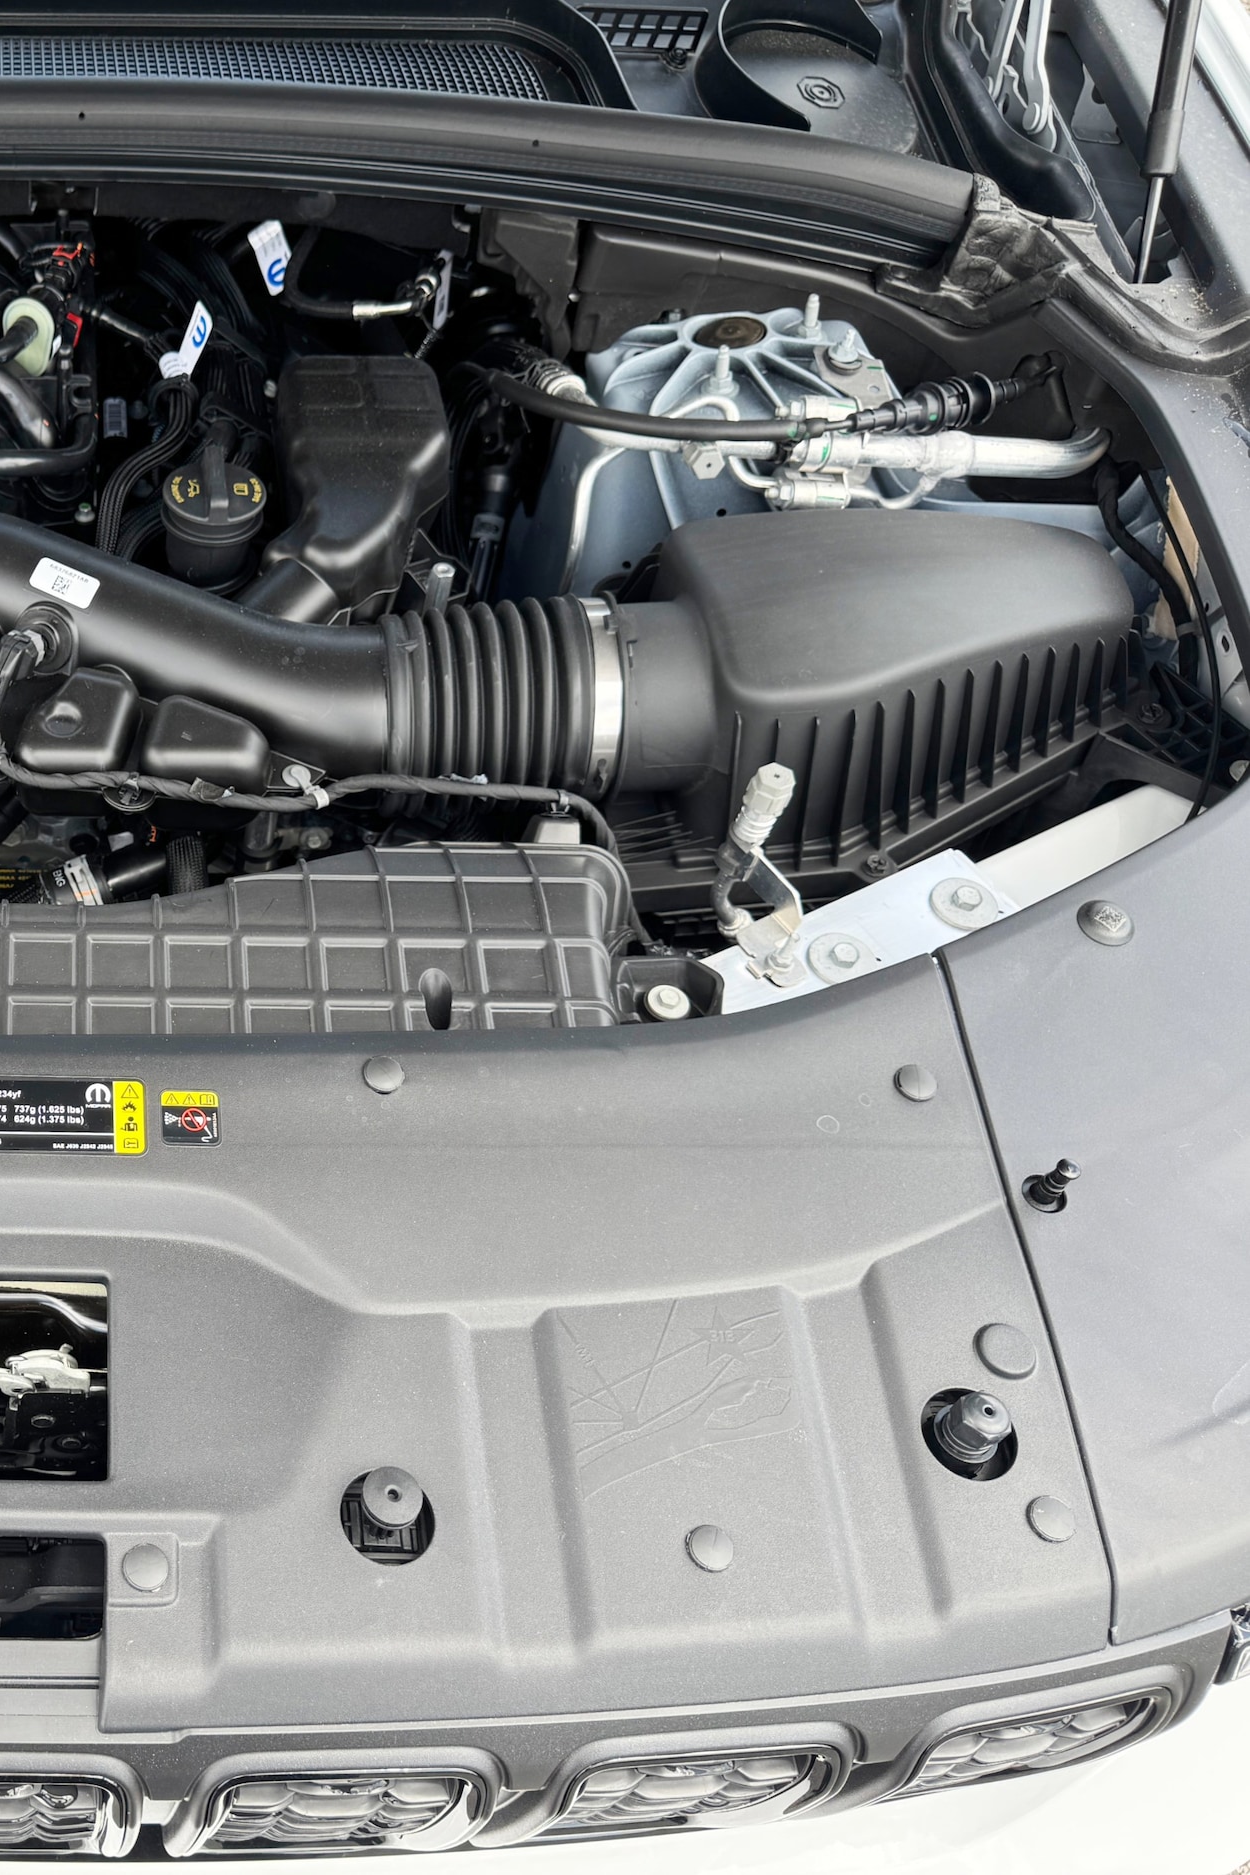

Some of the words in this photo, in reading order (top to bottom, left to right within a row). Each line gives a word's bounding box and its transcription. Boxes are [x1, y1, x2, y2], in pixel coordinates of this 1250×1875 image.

[52, 869, 66, 888] ENG
[13, 1104, 37, 1115] 737g
[37, 1105, 66, 1115] (1.625
[66, 1105, 85, 1116] lbs)
[13, 1114, 37, 1125] 624g
[37, 1115, 66, 1125] (1.375
[66, 1115, 85, 1126] lbs)
